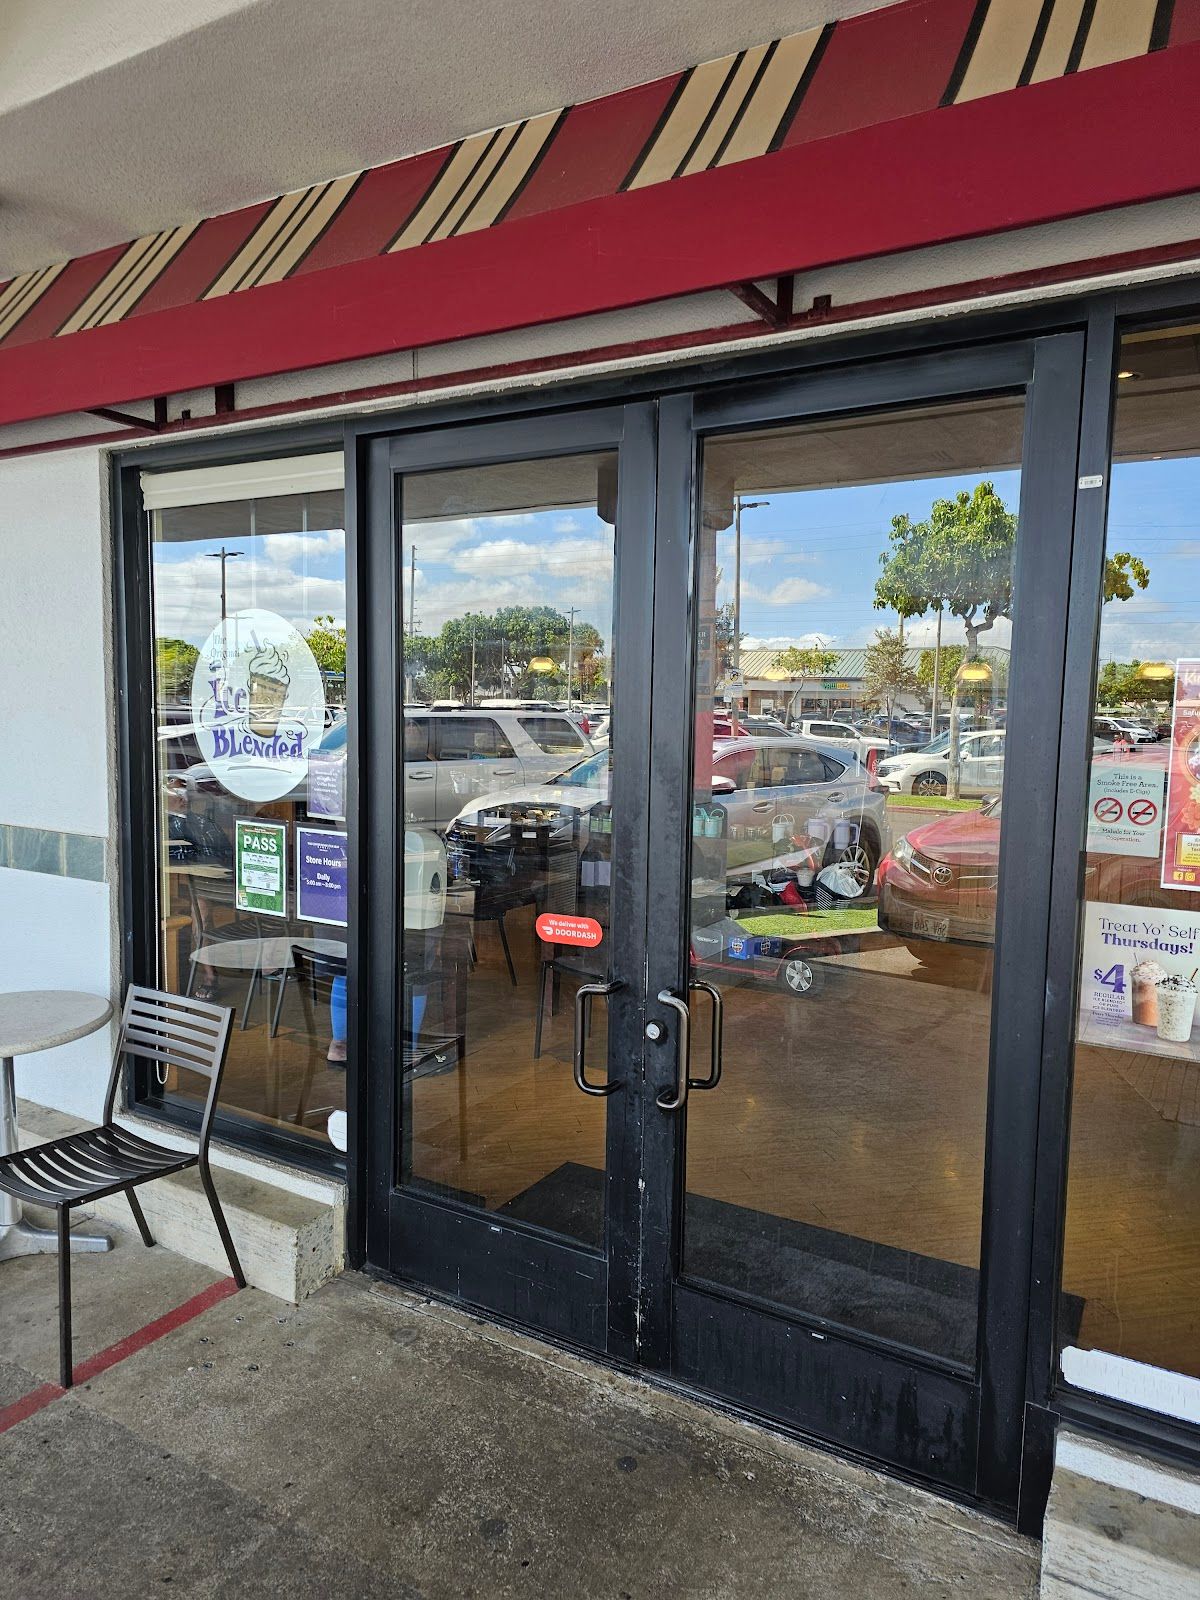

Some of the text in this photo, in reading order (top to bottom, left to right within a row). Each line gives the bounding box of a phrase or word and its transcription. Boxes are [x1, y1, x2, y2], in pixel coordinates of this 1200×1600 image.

[208, 668, 248, 718] Ice
[243, 835, 277, 853] PASS
[305, 855, 341, 867] Store Hours
[316, 872, 330, 882] Daily
[558, 920, 576, 928] deliver
[1099, 918, 1138, 934] Treat
[1168, 925, 1200, 940] Self
[555, 929, 597, 940] DOORDASH
[1101, 932, 1193, 955] Thursdays!
[1094, 964, 1127, 994] $4
[1093, 991, 1126, 1001] REGULAR
